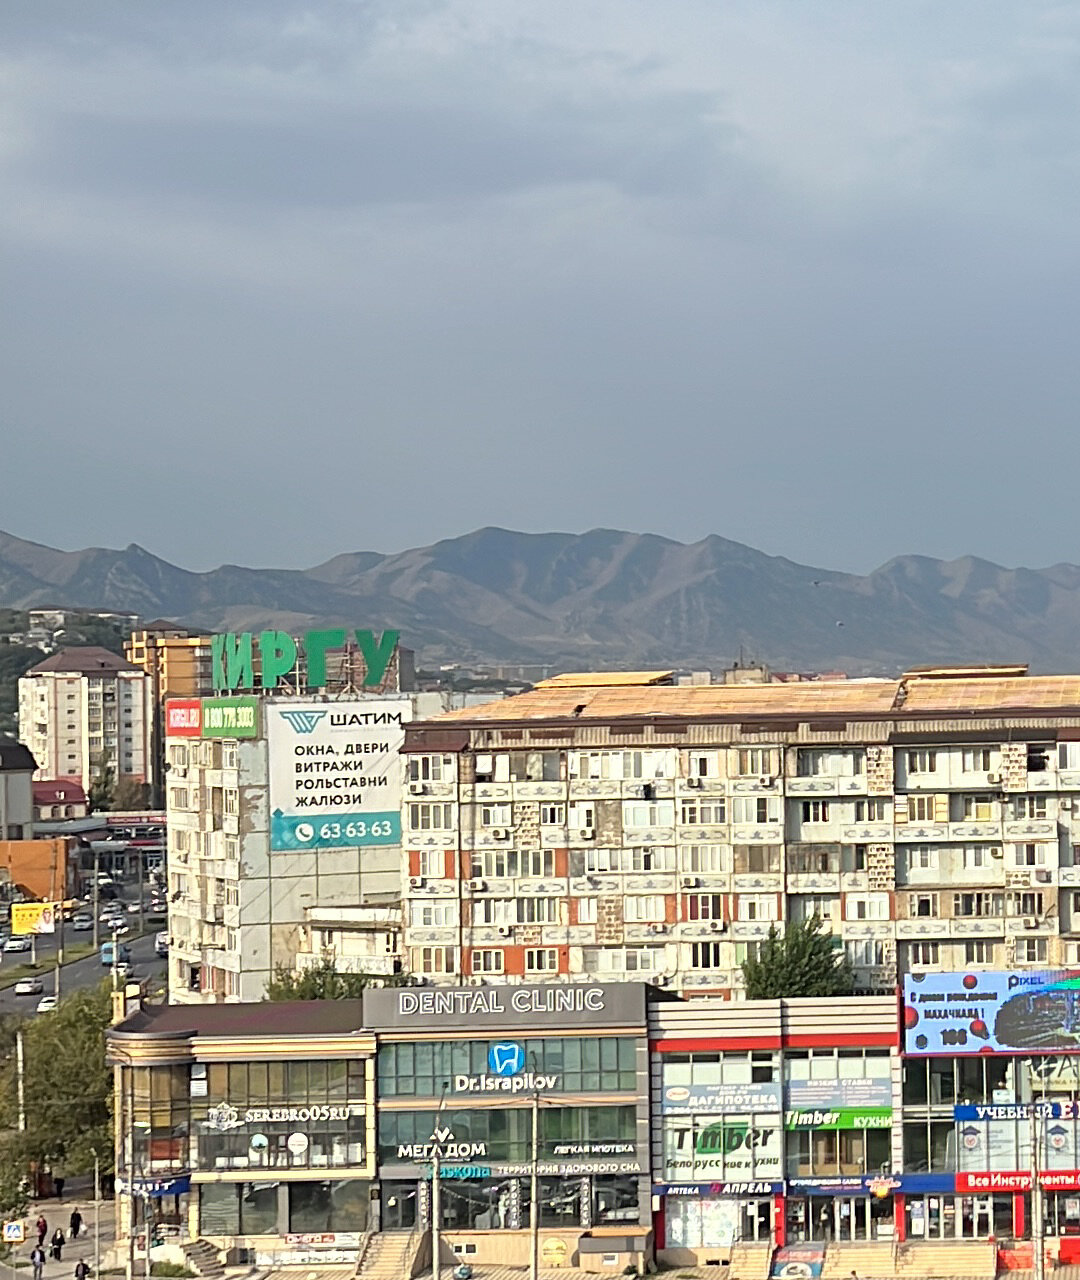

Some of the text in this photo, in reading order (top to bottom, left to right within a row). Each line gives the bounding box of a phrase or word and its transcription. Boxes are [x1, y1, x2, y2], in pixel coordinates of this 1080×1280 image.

[211, 628, 399, 689] КИРГУ
[330, 712, 403, 726] ШАТИМ
[294, 742, 390, 757] ОКНА, ДВЕРИ
[295, 760, 364, 773] ВИТРАЖИ
[295, 775, 388, 790] РОЛЬСТАВНИ
[295, 794, 363, 807] ЖАЛЮЗИ
[399, 988, 605, 1015] DENTAL CLINIC
[455, 1073, 559, 1094] Dr.Israpilov
[688, 1094, 778, 1107] ДАГИПОТЕКА
[784, 1110, 841, 1125] Timber
[853, 1115, 893, 1128] КУХНИ
[673, 1122, 774, 1150] Timber
[397, 1142, 487, 1158] МЕГА ДОМ
[591, 1144, 634, 1153] ИПОТЕКА
[560, 1162, 619, 1174] ЗДОРОВОГО
[620, 1162, 641, 1172] СНА
[667, 1182, 772, 1195] АПТЕКА АПРЕЛЬ
